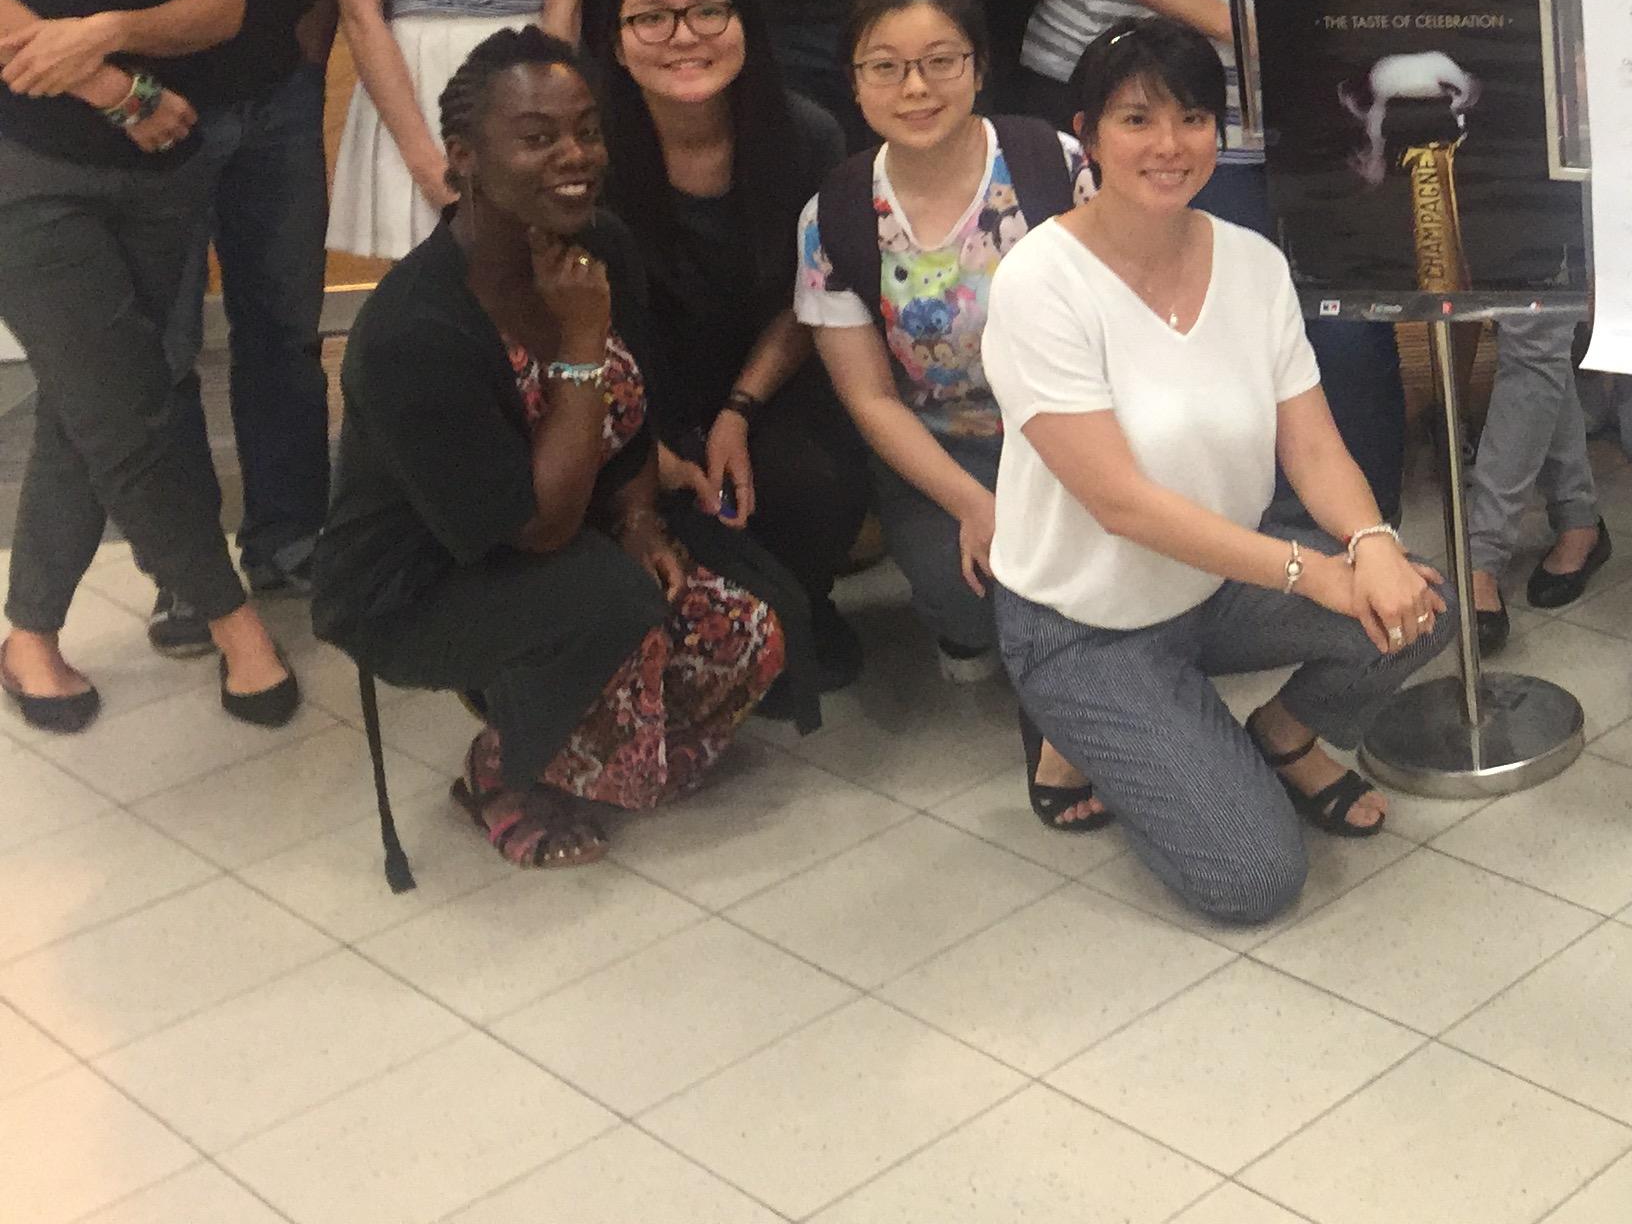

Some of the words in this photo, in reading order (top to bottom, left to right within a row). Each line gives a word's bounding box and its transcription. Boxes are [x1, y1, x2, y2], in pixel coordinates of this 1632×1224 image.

[1323, 15, 1349, 29] THE
[1351, 15, 1390, 29] TASTE
[1391, 15, 1410, 28] OF
[1415, 14, 1504, 28] CELEBRATION
